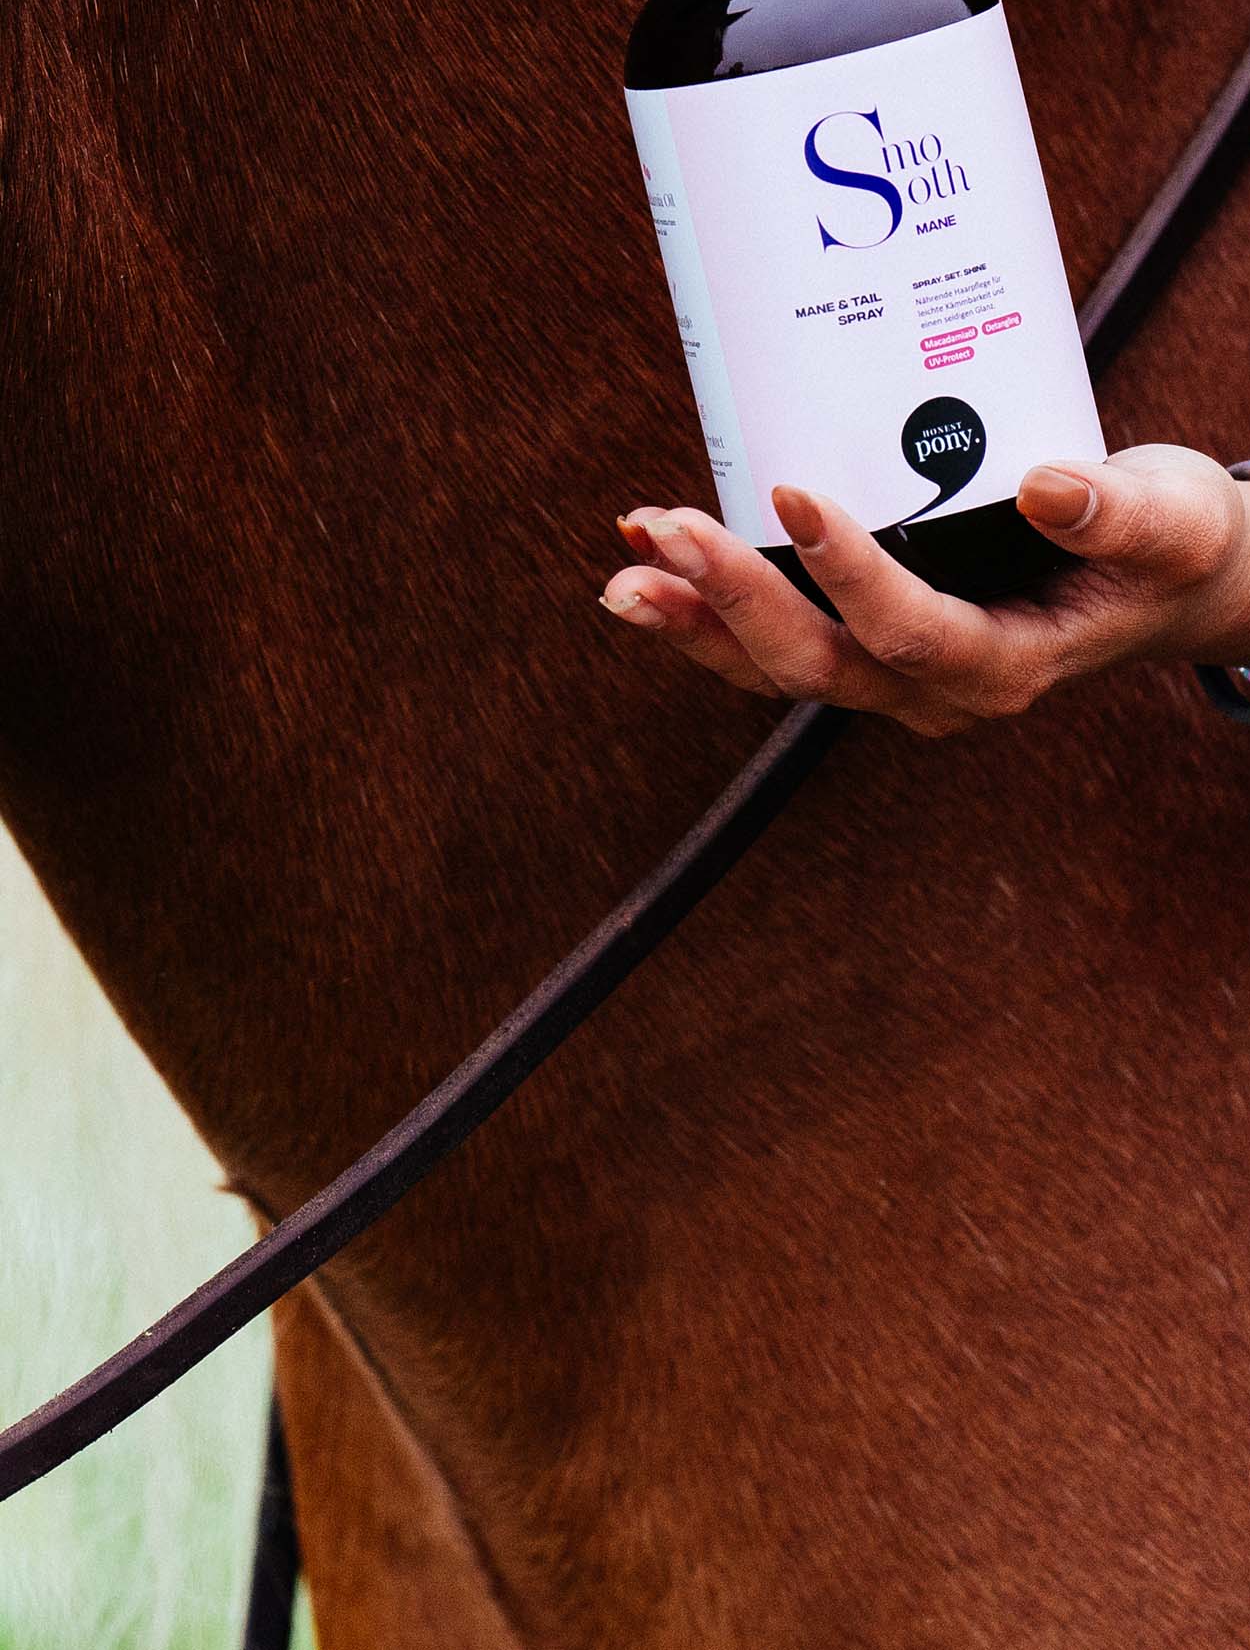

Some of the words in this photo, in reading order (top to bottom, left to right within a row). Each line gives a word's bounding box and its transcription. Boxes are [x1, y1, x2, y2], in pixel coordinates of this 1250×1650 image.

[916, 214, 957, 236] MANE
[992, 286, 1005, 297] und
[795, 302, 835, 319] MANE
[838, 299, 849, 310] &
[850, 293, 883, 307] TAIL
[838, 306, 884, 326] SPRAY
[920, 318, 943, 329] einen
[928, 349, 971, 367] UV-Protect
[922, 421, 962, 438] HONEST
[914, 428, 981, 463] pony.
